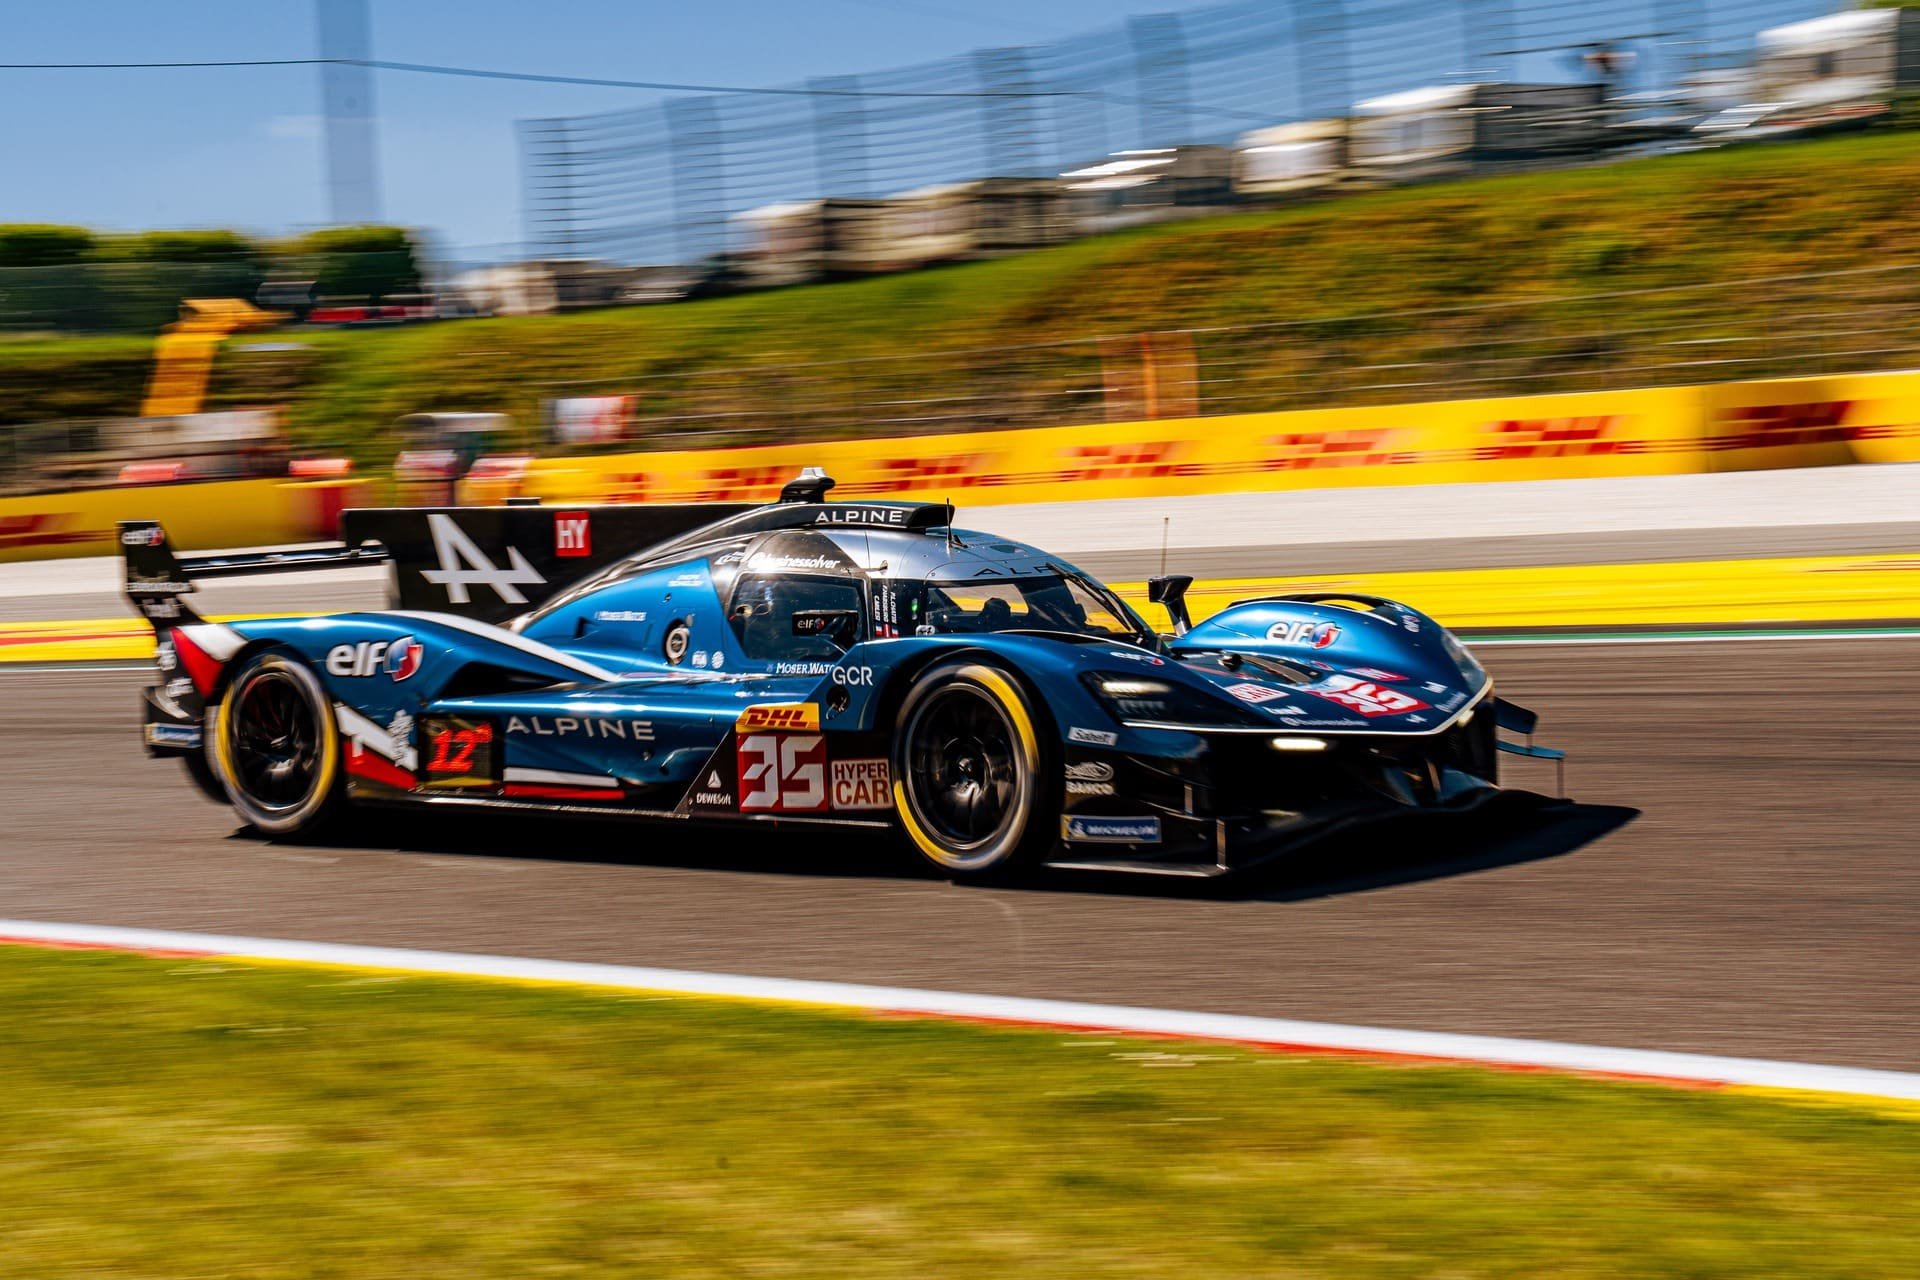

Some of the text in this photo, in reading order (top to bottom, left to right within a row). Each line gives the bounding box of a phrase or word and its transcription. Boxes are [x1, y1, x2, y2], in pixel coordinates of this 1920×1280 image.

[815, 510, 903, 523] ALPINE
[555, 519, 588, 549] HY
[797, 619, 814, 629] elf
[1266, 622, 1316, 642] elf
[326, 642, 389, 676] elf
[832, 666, 874, 686] GCR
[506, 716, 655, 740] ALPINE
[746, 709, 810, 728] DHL
[739, 736, 824, 808] 35
[834, 763, 888, 780] HYPER
[836, 780, 889, 805] CAR
